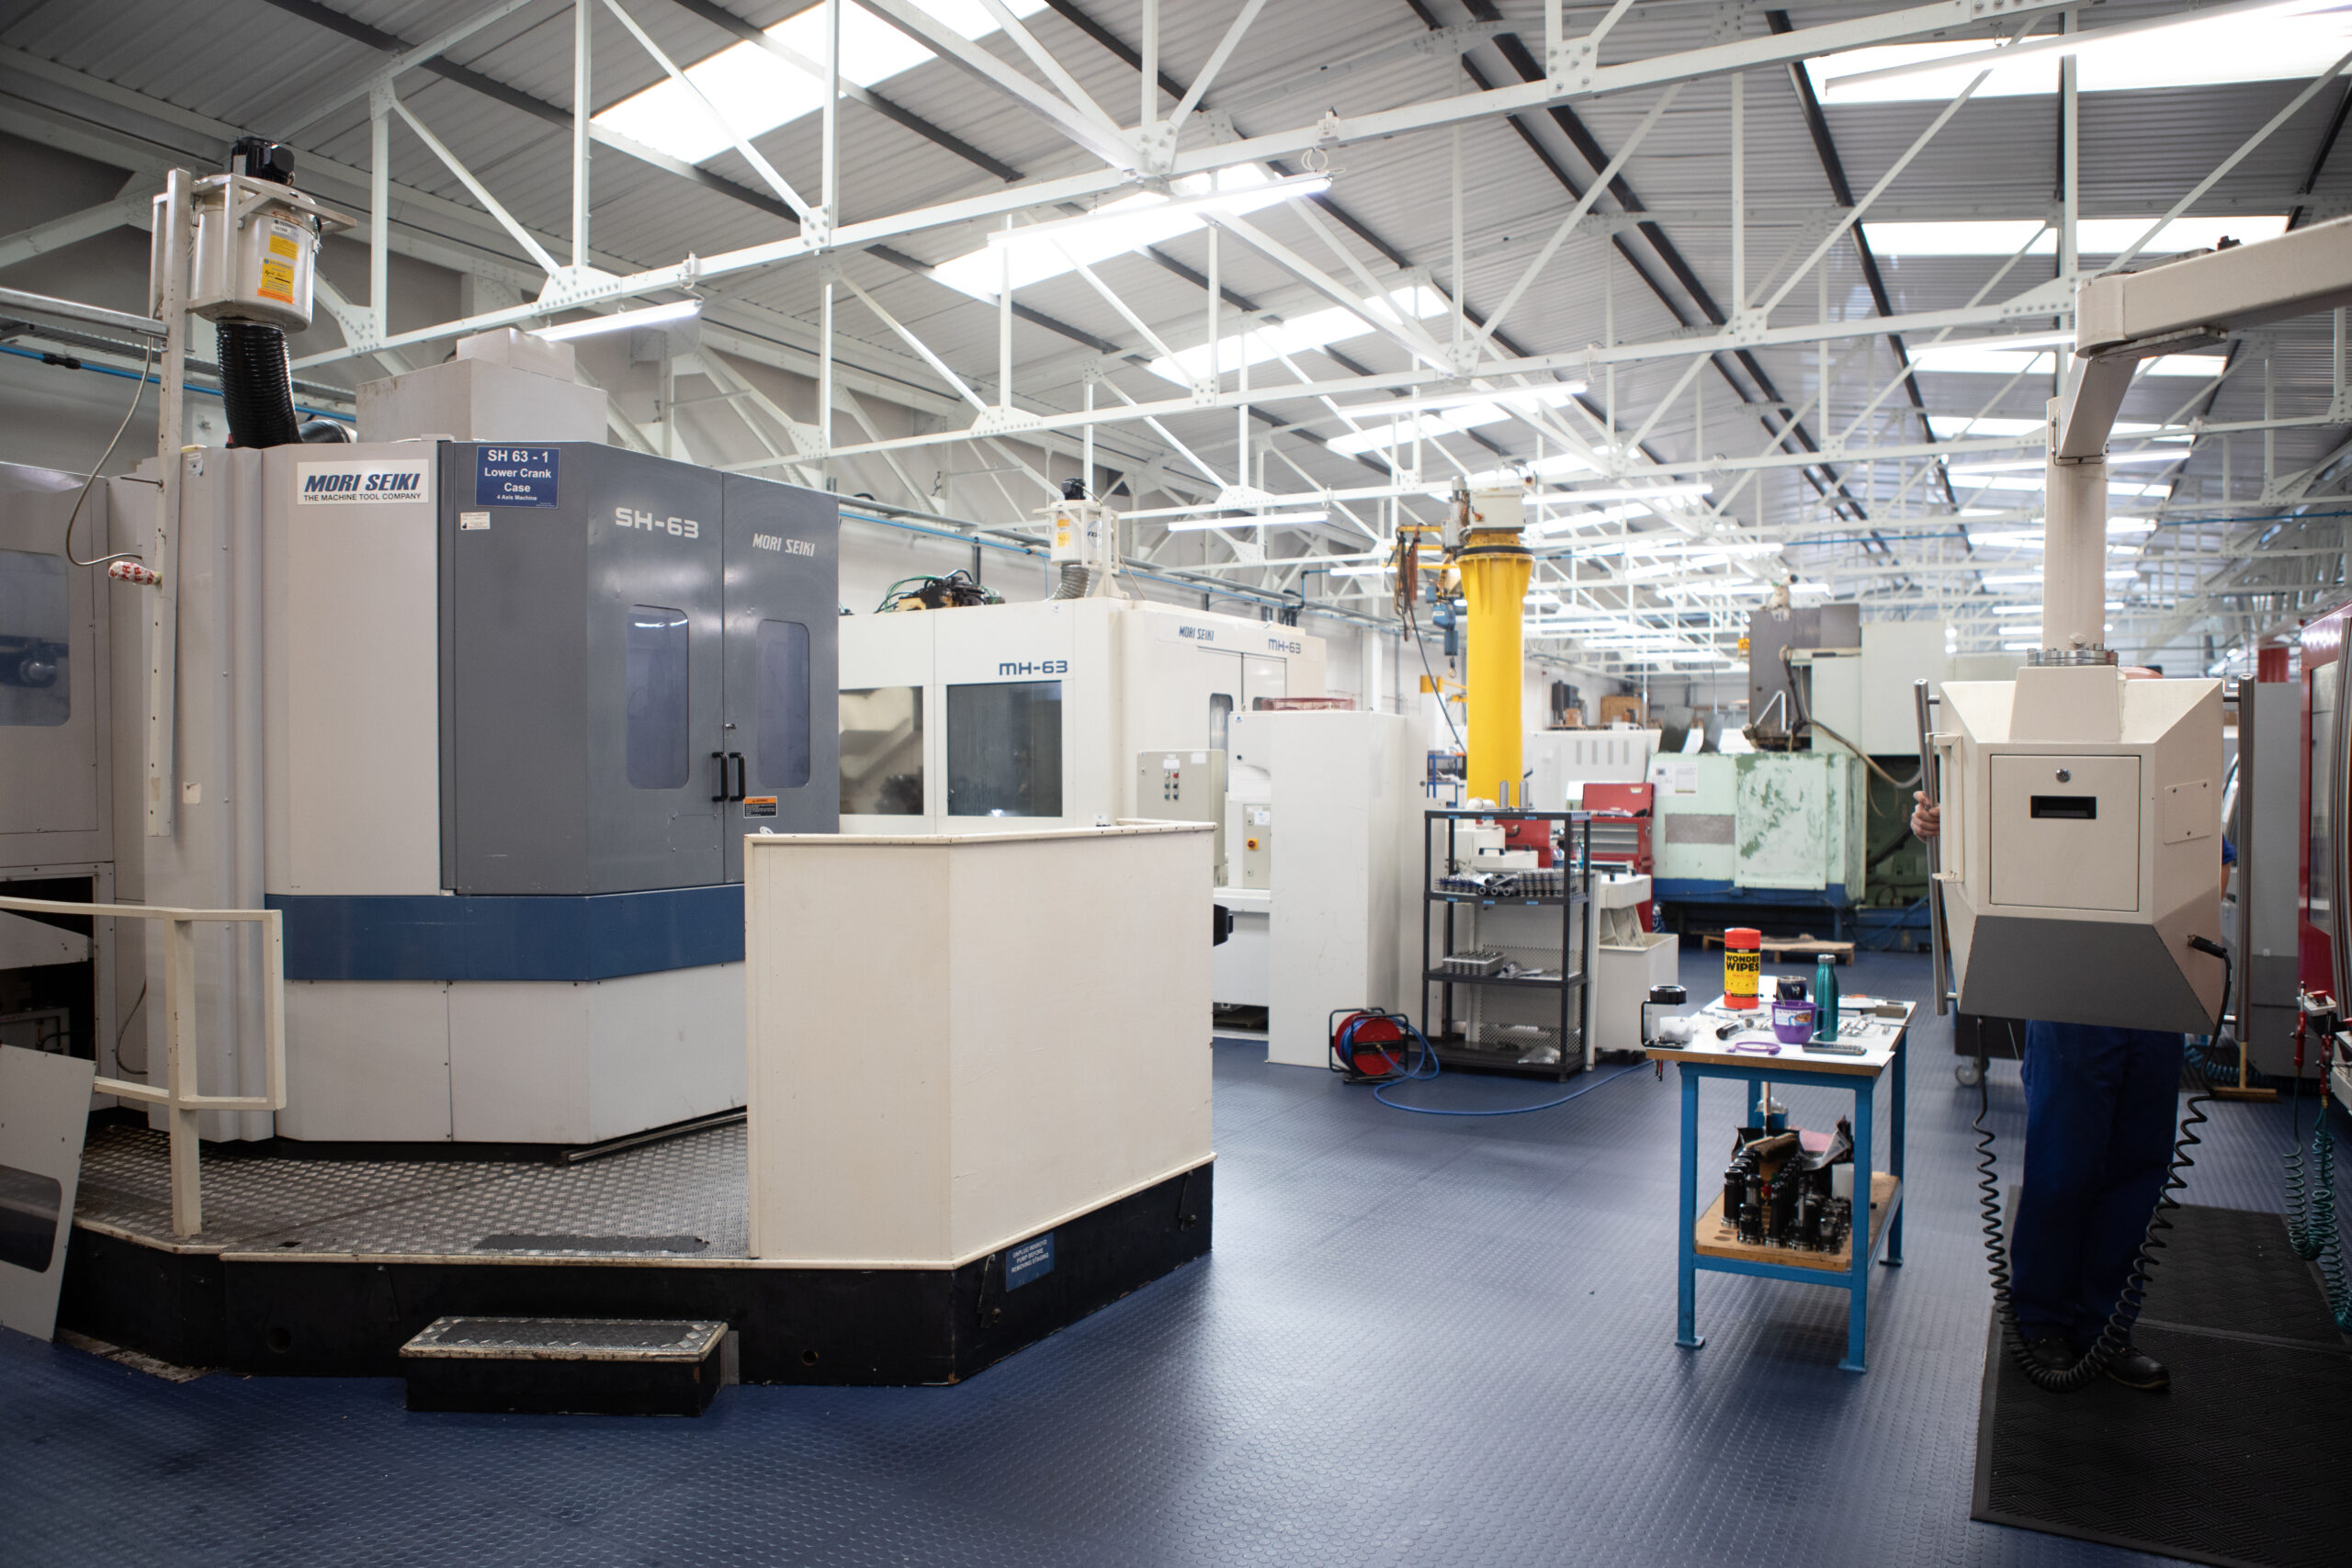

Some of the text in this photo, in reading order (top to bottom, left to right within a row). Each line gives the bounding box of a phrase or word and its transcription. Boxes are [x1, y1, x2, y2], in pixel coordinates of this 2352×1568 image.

[487, 449, 508, 462] SH
[512, 450, 528, 463] 63
[542, 451, 548, 463] 1
[484, 467, 551, 479] Lower Crank
[304, 473, 421, 492] MORI SEIKI
[503, 482, 531, 492] Case
[615, 506, 699, 539] SH-63
[752, 533, 816, 557] MORI SEIKI
[1179, 626, 1215, 641] MORI SEIKI
[1268, 638, 1301, 655] MH-63
[999, 660, 1068, 676] MH-63
[1726, 962, 1759, 972] WIPES
[1016, 1247, 1044, 1264] PUMP BEFORE
[1012, 1259, 1032, 1273] REMOVING
